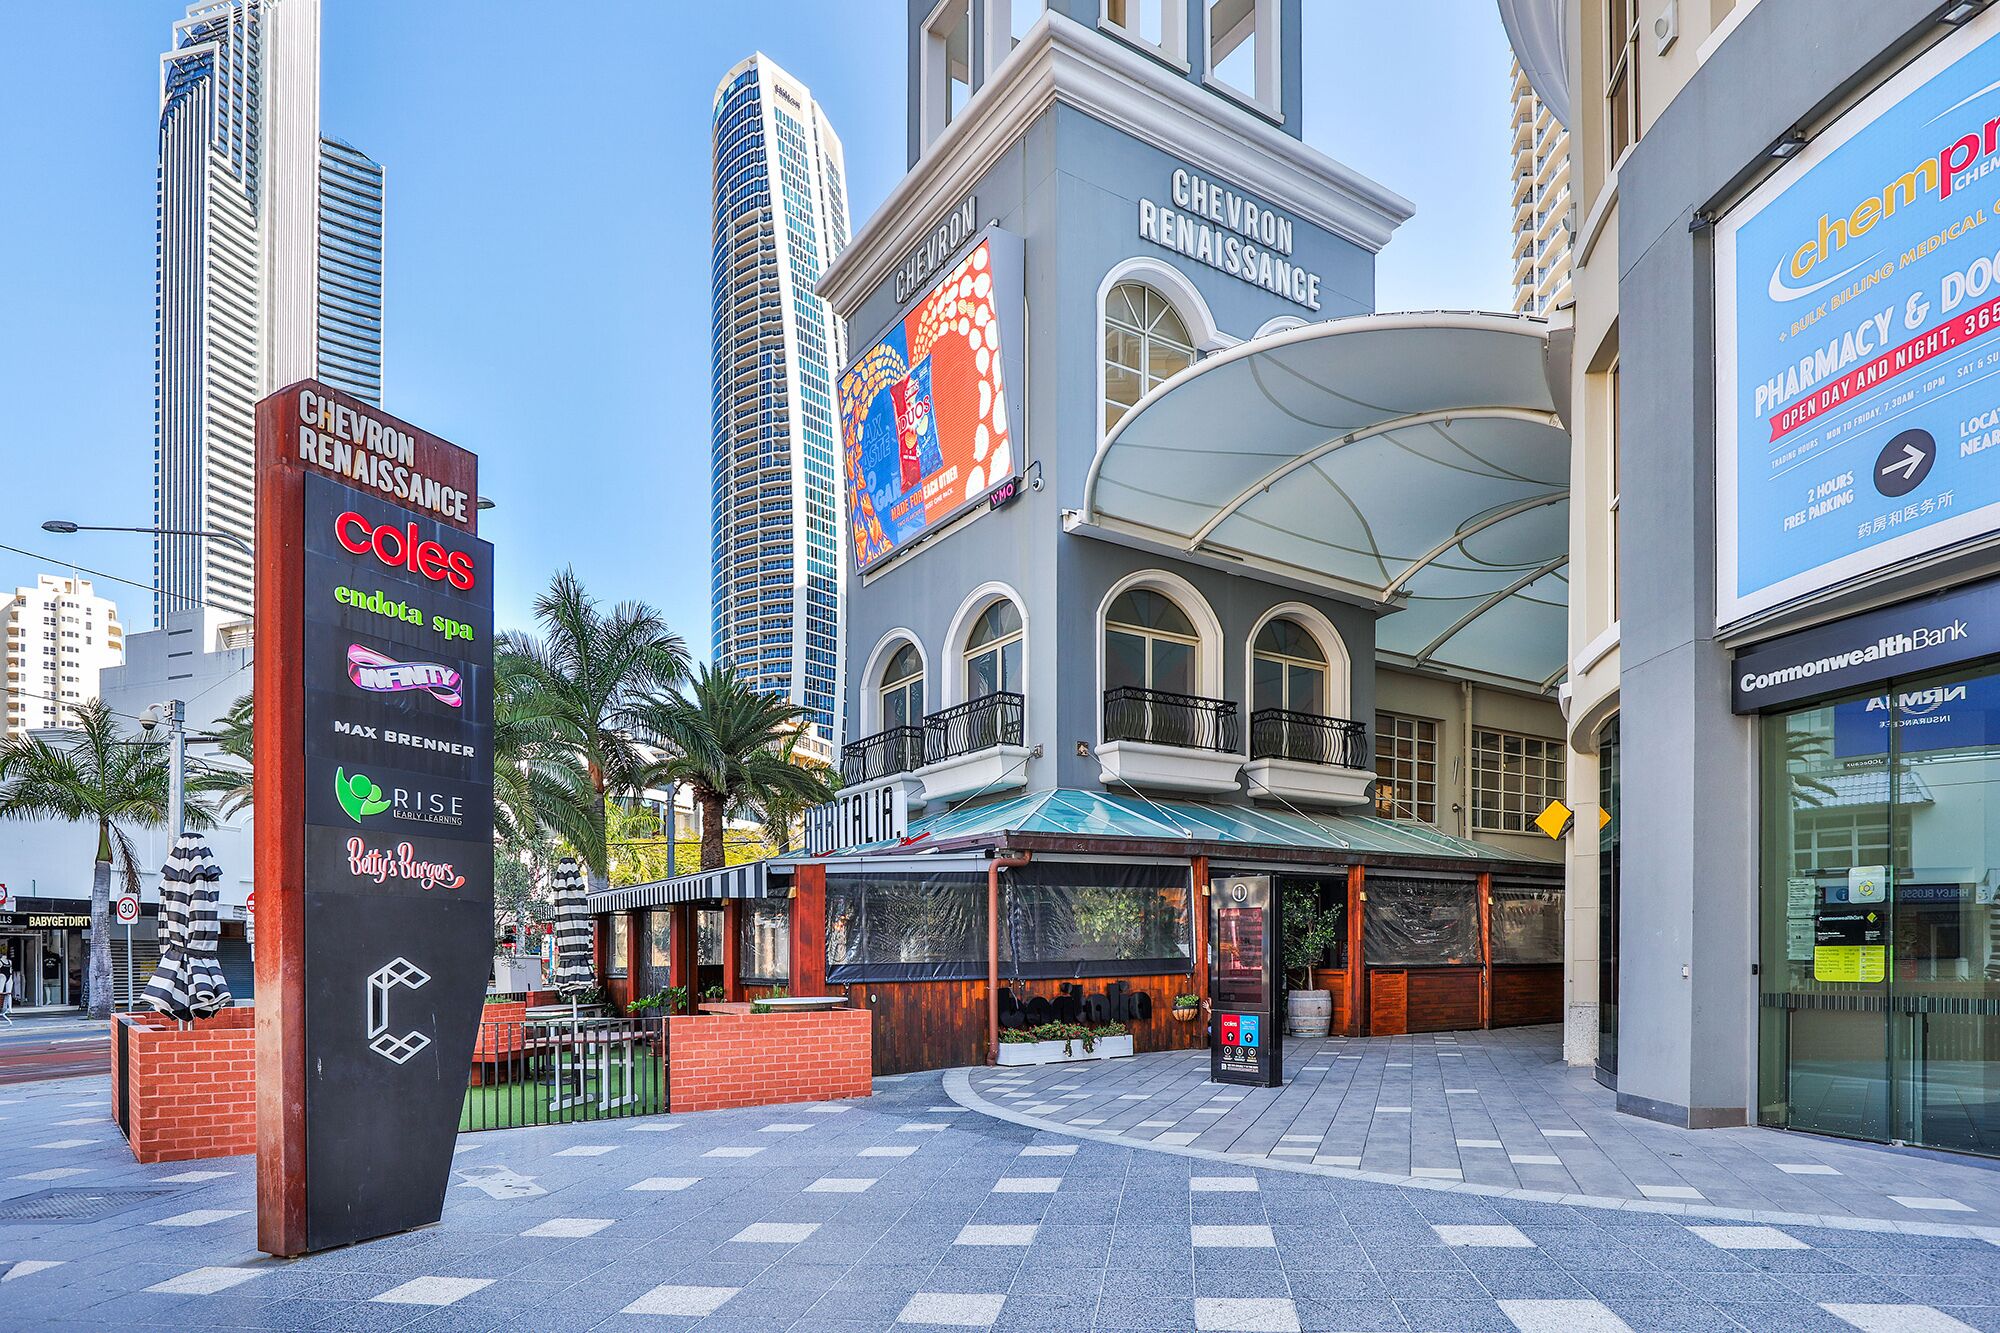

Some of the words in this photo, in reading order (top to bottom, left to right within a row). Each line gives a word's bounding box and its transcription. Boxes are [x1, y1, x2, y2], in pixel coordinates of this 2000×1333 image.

[1172, 168, 1293, 257] CHEVRON
[895, 196, 977, 304] CHEVRON
[1139, 198, 1321, 311] RENAISSANCE
[1791, 301, 1827, 337] BULK
[1831, 261, 1895, 311] BILLING
[1898, 210, 1987, 270] MEDICAL
[1755, 306, 1895, 418] PHARMACY
[1904, 291, 1930, 330] &
[1941, 249, 2000, 314] DO
[1782, 399, 1817, 431] OPEN
[1821, 380, 1851, 408] DAY
[1856, 360, 1888, 390] AND
[1895, 326, 1956, 370] NIGHT,
[1964, 302, 2000, 336] 365
[299, 389, 415, 467] CHEVRON
[897, 394, 931, 435] DUOS
[1771, 450, 1797, 469] TRADING
[1797, 438, 1818, 457] HOURS
[1826, 425, 1842, 441] MON
[1844, 421, 1852, 432] TO
[1884, 391, 1914, 412] 7.30AM
[1922, 375, 1946, 395] 10PM
[1957, 362, 1974, 378] SAT
[1977, 358, 1984, 369] &
[299, 425, 468, 523] RENAISSANCE
[863, 433, 891, 471] ASTE
[891, 500, 909, 522] MADE
[910, 491, 923, 509] FOR
[923, 477, 939, 499] EACH
[1784, 512, 1806, 532] FREE
[1808, 489, 1854, 521] PARKING
[1807, 488, 1815, 503] 2
[1817, 470, 1854, 500] HOURS
[1857, 489, 1955, 540] 药房和医务所
[335, 511, 475, 590] coles
[334, 585, 423, 626] endota
[433, 615, 474, 642] spa
[359, 665, 454, 690] INFINITY
[1740, 620, 1968, 692] CommonwealthBank
[334, 720, 378, 740] MAX
[384, 730, 475, 758] BRENNER
[394, 788, 463, 816] RISE
[394, 810, 421, 821] EARLY
[424, 813, 463, 825] LEARNING
[347, 836, 397, 884] Betty's
[398, 842, 466, 890] Burgers
[121, 903, 134, 914] 30
